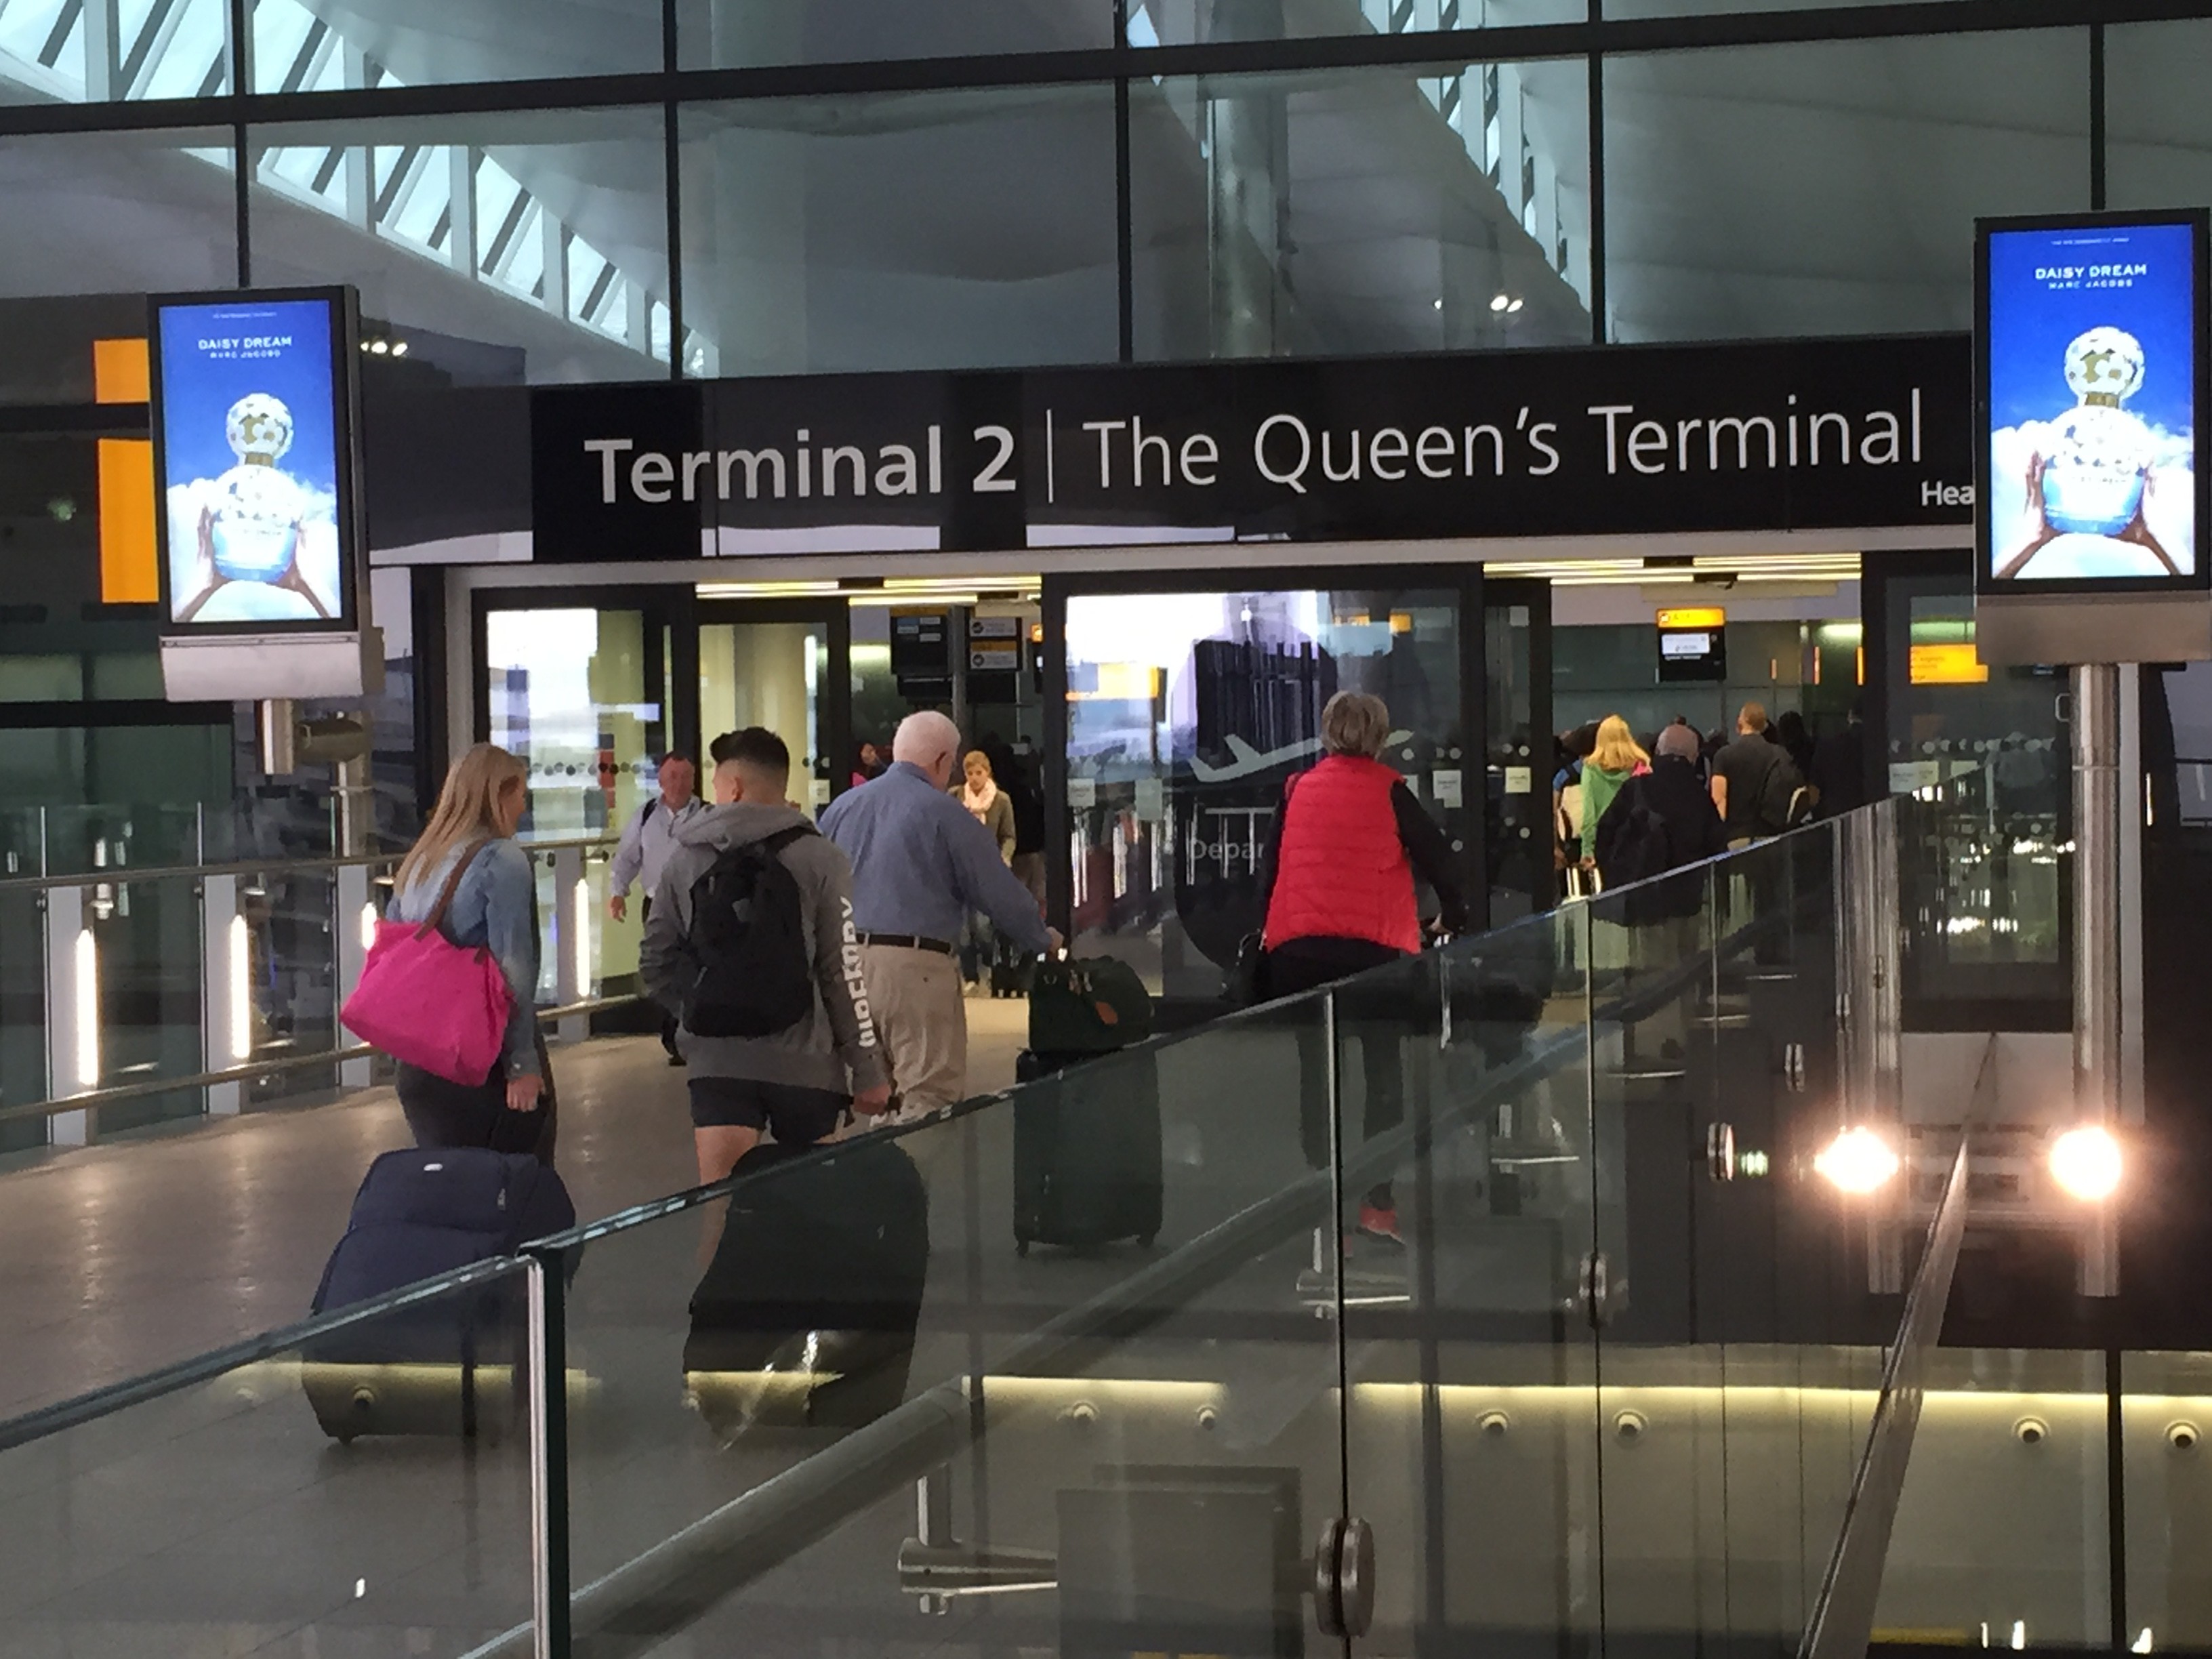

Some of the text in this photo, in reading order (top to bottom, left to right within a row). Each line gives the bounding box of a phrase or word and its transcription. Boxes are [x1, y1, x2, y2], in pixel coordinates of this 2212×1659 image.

[2034, 263, 2147, 280] DAISY DREAM
[243, 335, 293, 349] DREAM
[585, 388, 1920, 502] Terminal 2 The Queen's Terminal
[1921, 479, 1974, 507] Hea
